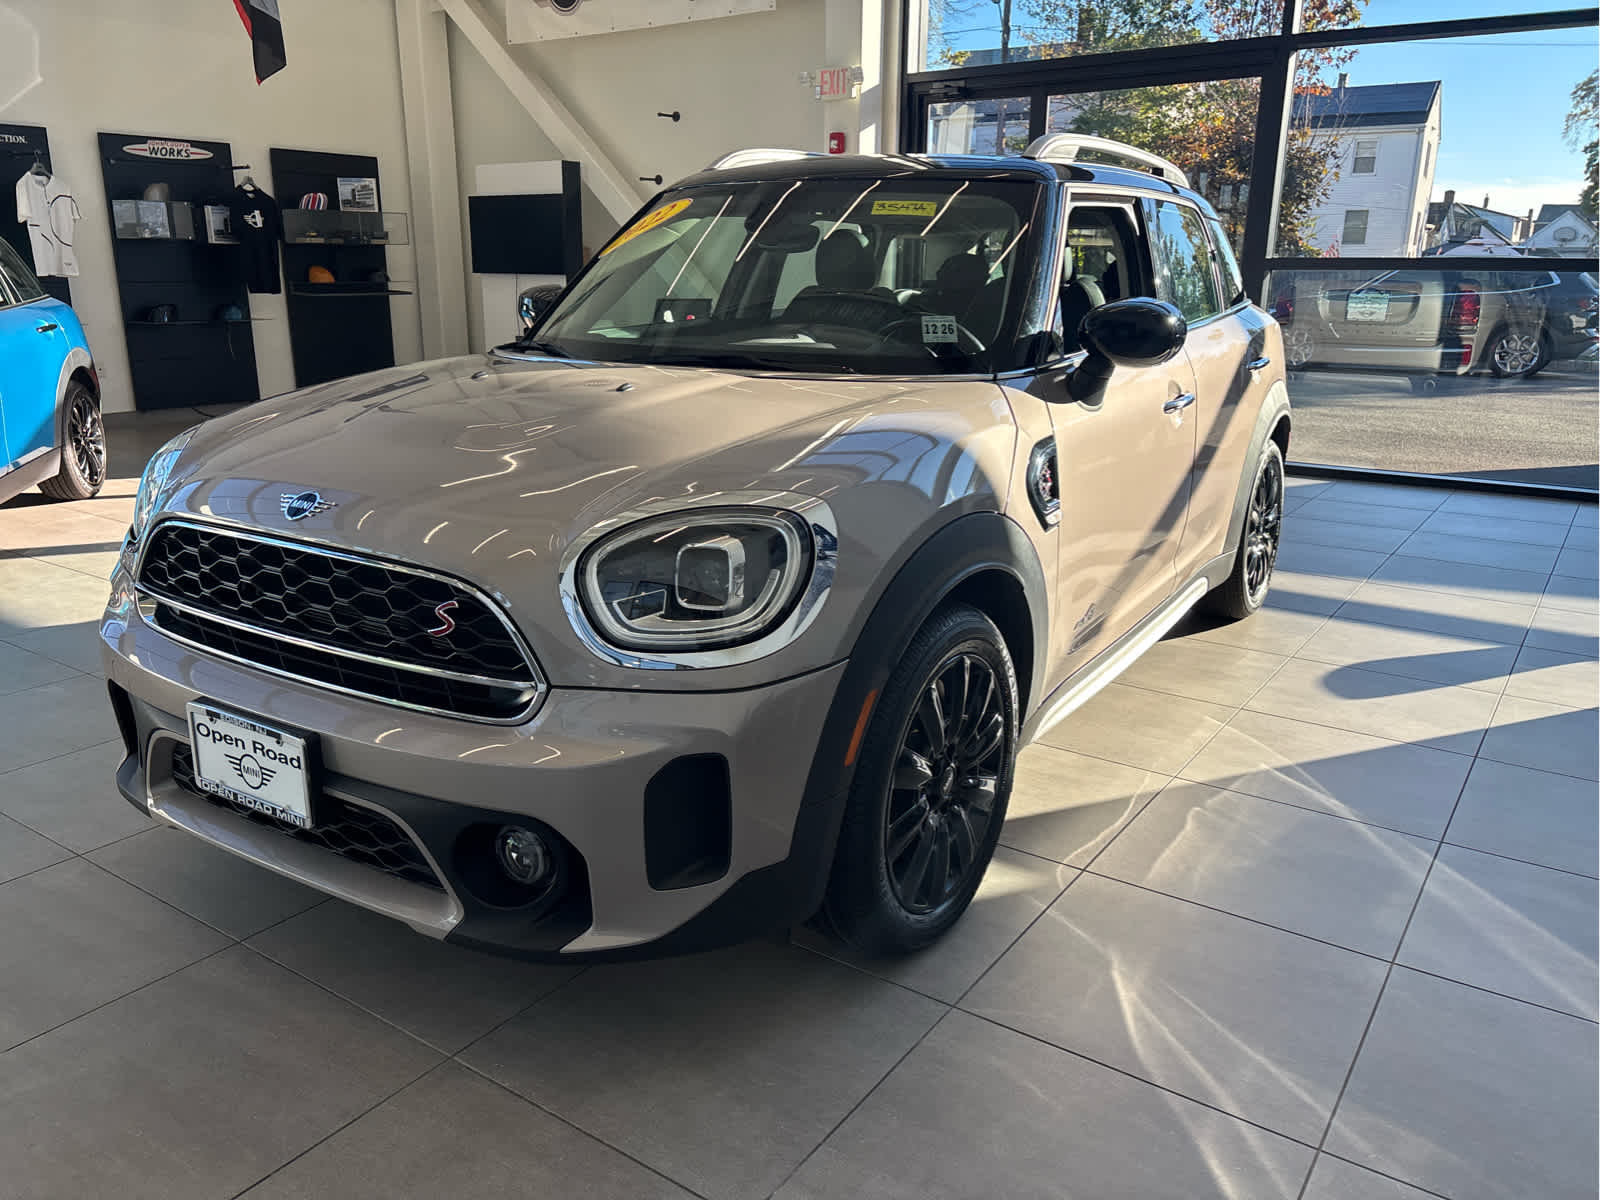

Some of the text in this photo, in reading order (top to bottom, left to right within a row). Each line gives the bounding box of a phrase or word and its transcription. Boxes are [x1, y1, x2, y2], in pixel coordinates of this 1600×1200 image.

[820, 68, 848, 96] EXIT
[148, 146, 191, 158] WORKS
[924, 323, 954, 335] 12 26
[290, 499, 314, 510] MINI
[427, 600, 459, 637] S
[196, 722, 302, 770] Open Road
[243, 764, 261, 779] MINI
[201, 780, 305, 828] OPEN ROAD MINI
